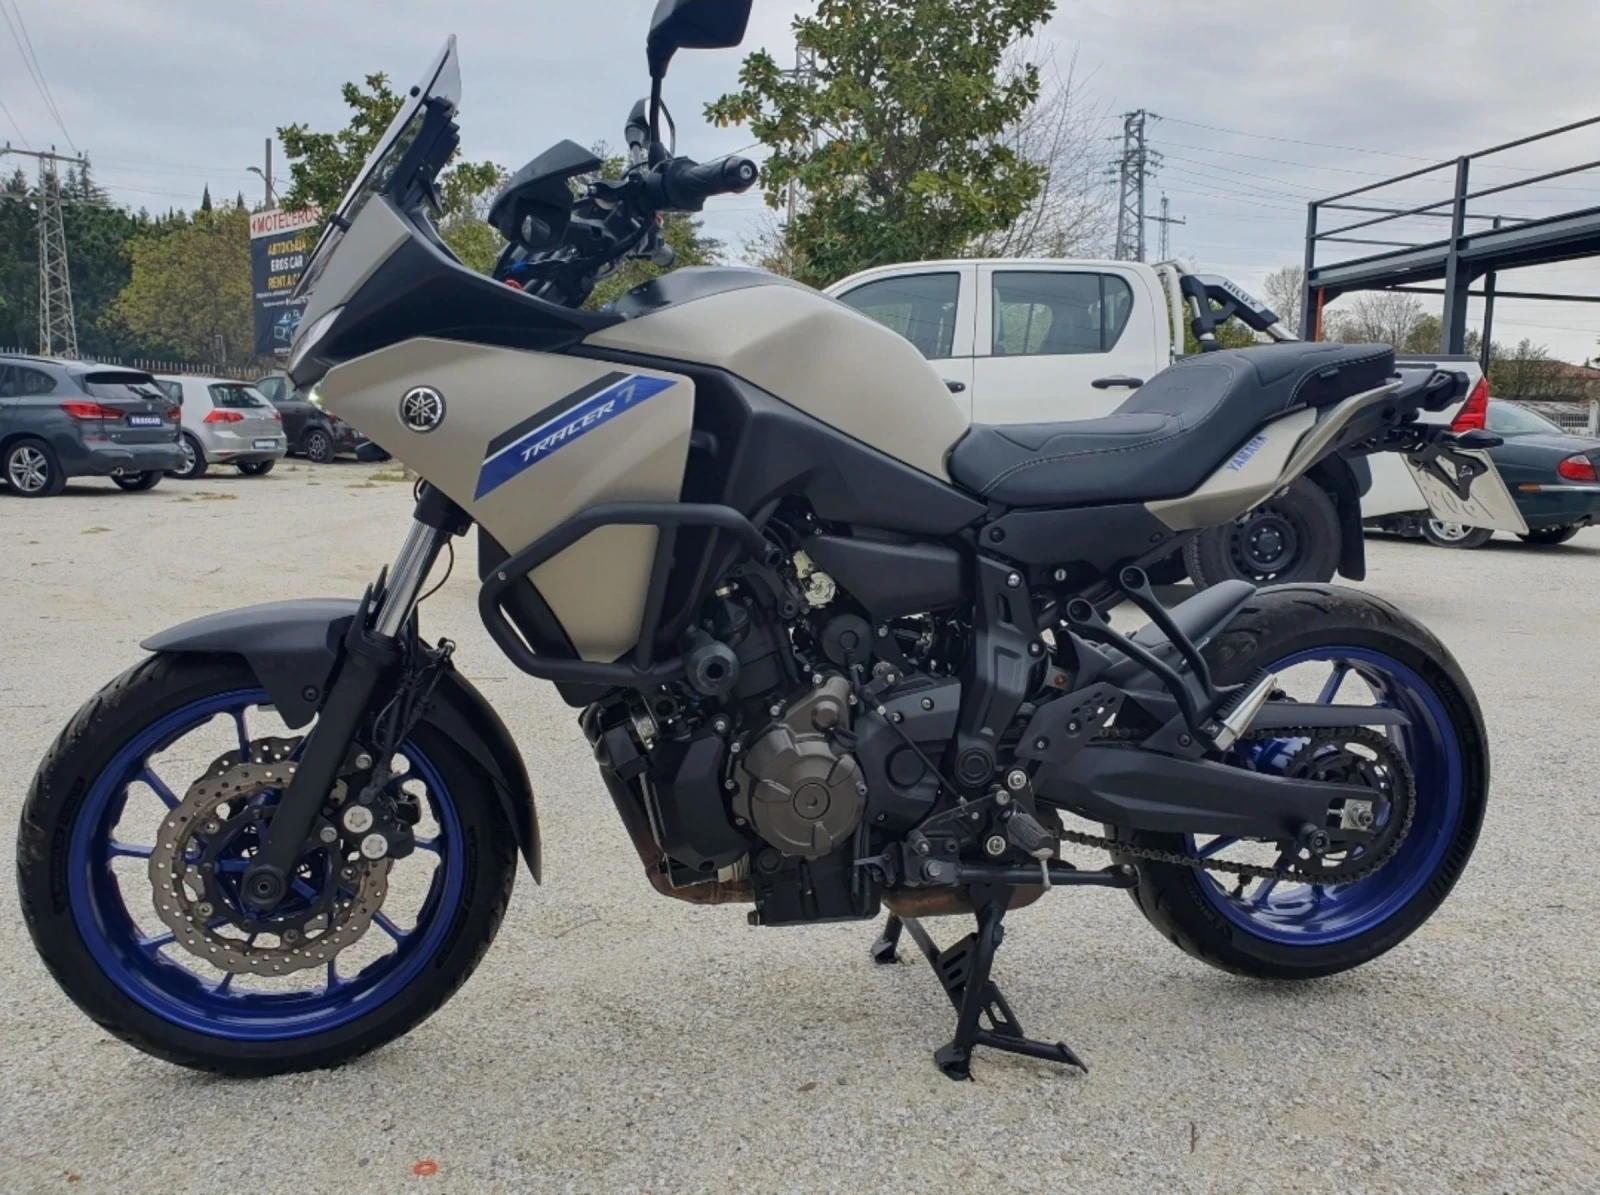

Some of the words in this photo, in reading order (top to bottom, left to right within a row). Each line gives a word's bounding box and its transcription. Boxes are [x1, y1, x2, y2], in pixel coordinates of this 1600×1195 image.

[258, 212, 291, 233] MOTEL
[271, 257, 289, 272] EROS
[289, 254, 304, 269] CAR
[268, 275, 286, 289] RENT
[1223, 281, 1256, 308] HILUX
[520, 399, 616, 462] TRACER
[616, 383, 637, 404] 7
[1226, 435, 1268, 471] YAMAHA
